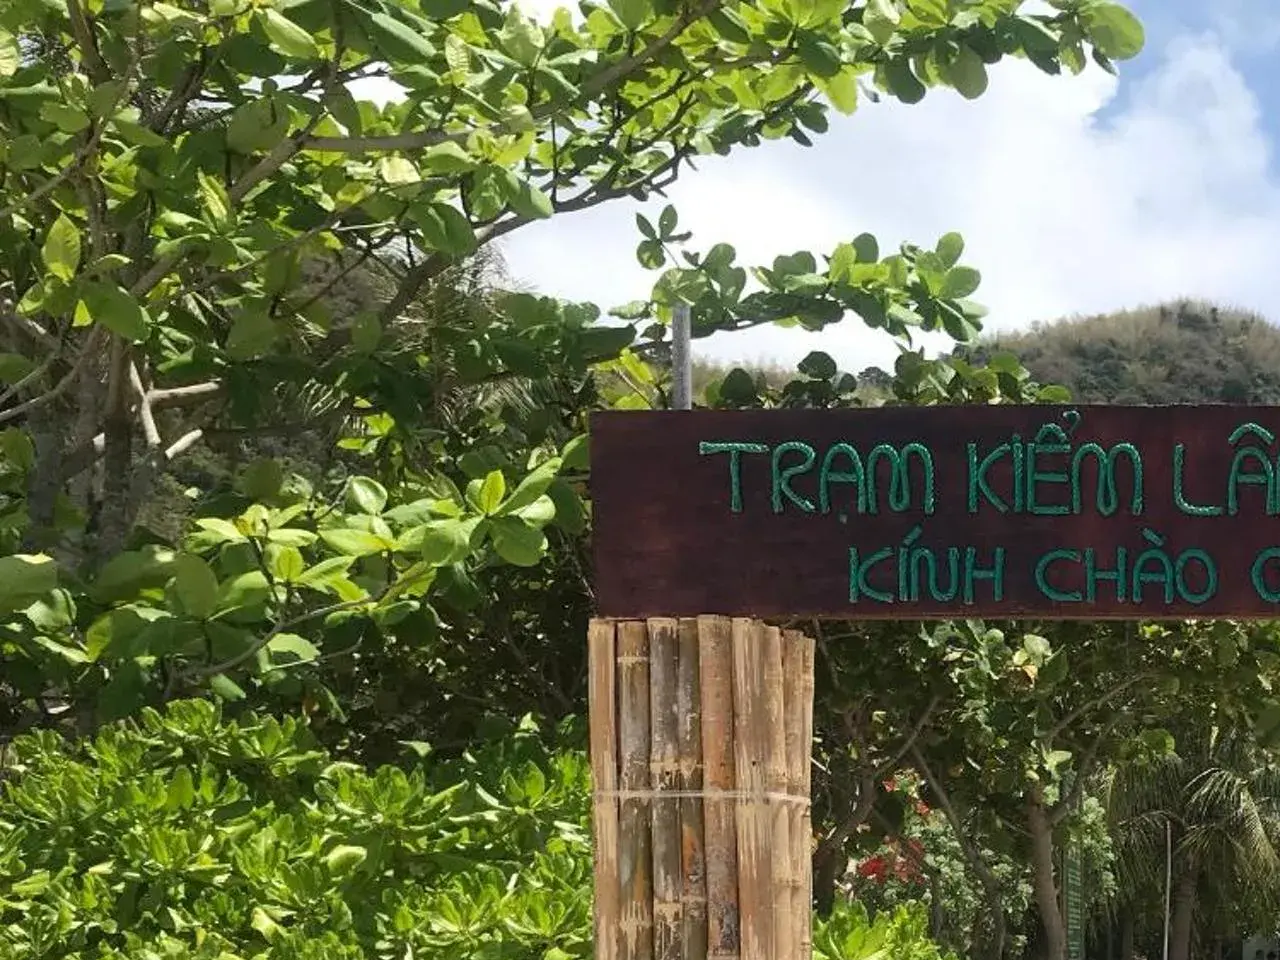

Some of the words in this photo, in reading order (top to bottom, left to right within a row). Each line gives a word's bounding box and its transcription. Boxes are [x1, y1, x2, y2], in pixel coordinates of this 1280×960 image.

[699, 441, 934, 523] TRẠM
[967, 411, 1143, 515] KIỂM
[849, 526, 1004, 604] KÍNH
[1035, 528, 1218, 604] CHÀO
